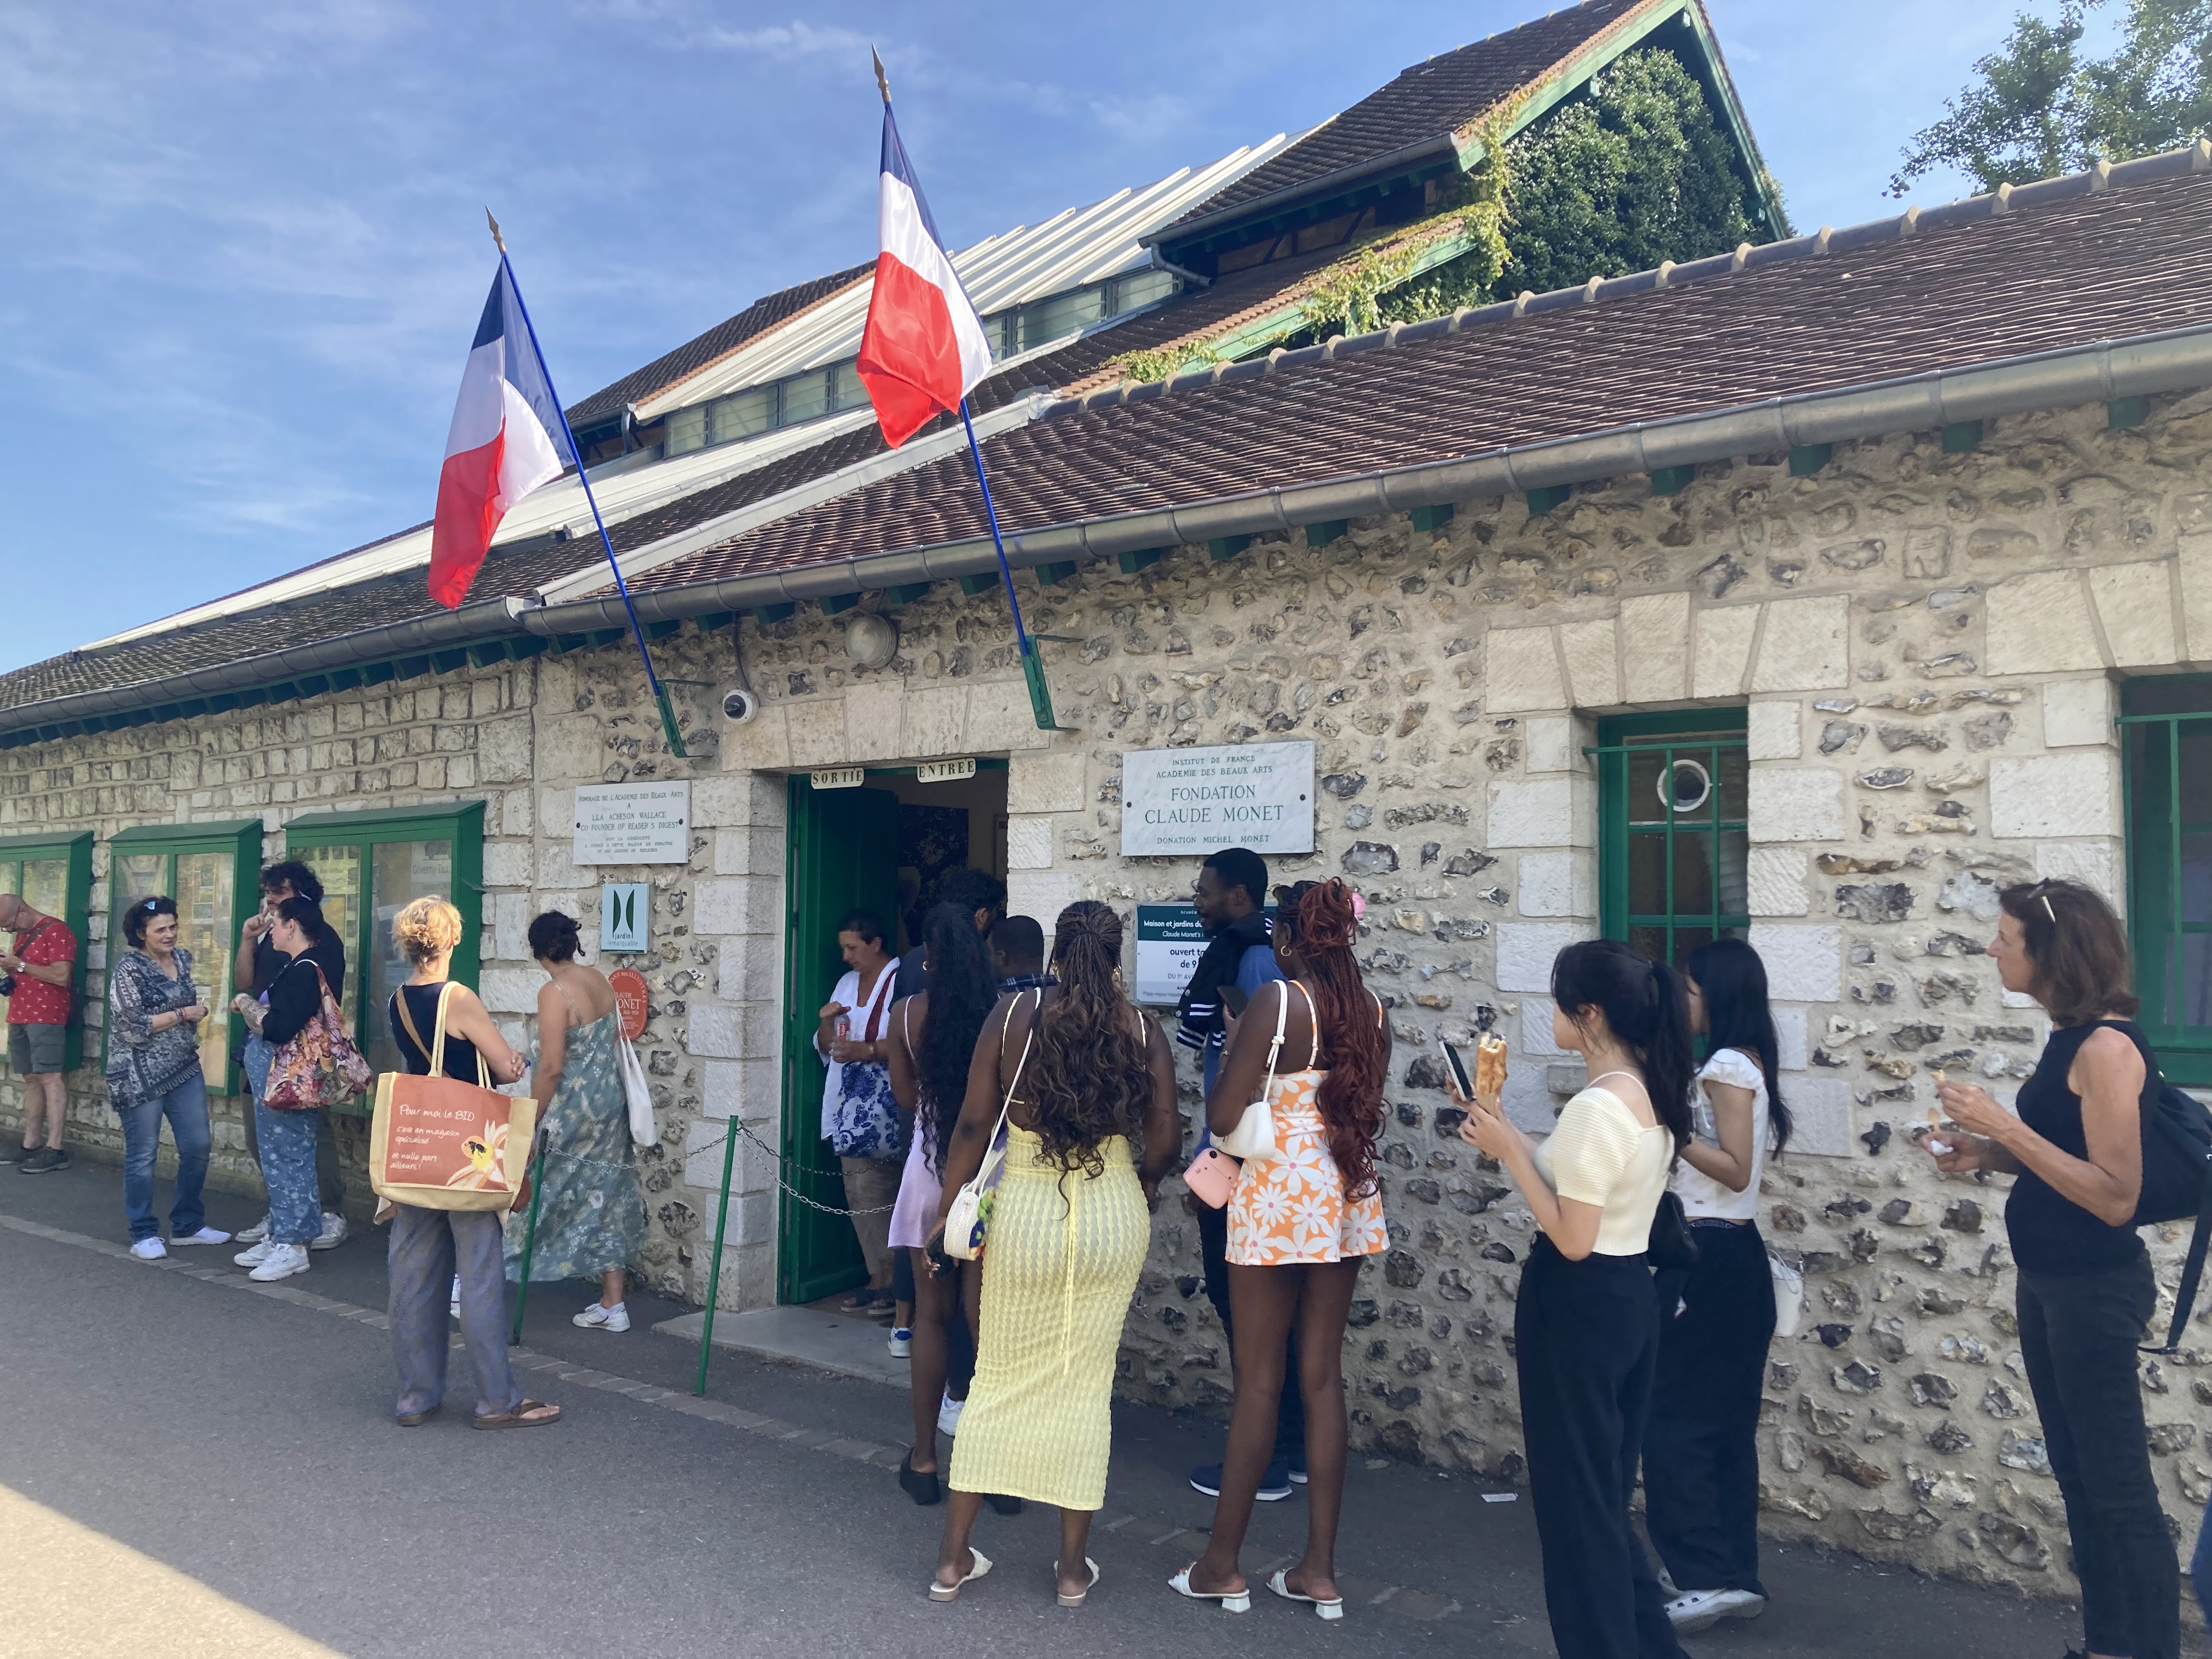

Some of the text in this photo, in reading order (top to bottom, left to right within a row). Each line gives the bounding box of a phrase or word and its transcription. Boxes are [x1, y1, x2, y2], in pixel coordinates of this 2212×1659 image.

[1156, 765, 1273, 778] ACADEMIE DES BEAUX ARTS
[812, 770, 863, 785] SORTIE
[1171, 785, 1256, 801] FONDATION
[1145, 805, 1284, 823] CLAUDE MONET
[1203, 835, 1233, 843] MICHEL
[1240, 834, 1270, 843] MONET
[1172, 920, 1194, 929] jardins
[615, 932, 630, 940] jardin
[1181, 960, 1190, 968] de
[618, 998, 641, 1009] ONET
[399, 1104, 475, 1121] Pour moi le BIO
[426, 1128, 460, 1138] magasin
[401, 1152, 420, 1160] nulle
[421, 1154, 437, 1163] part
